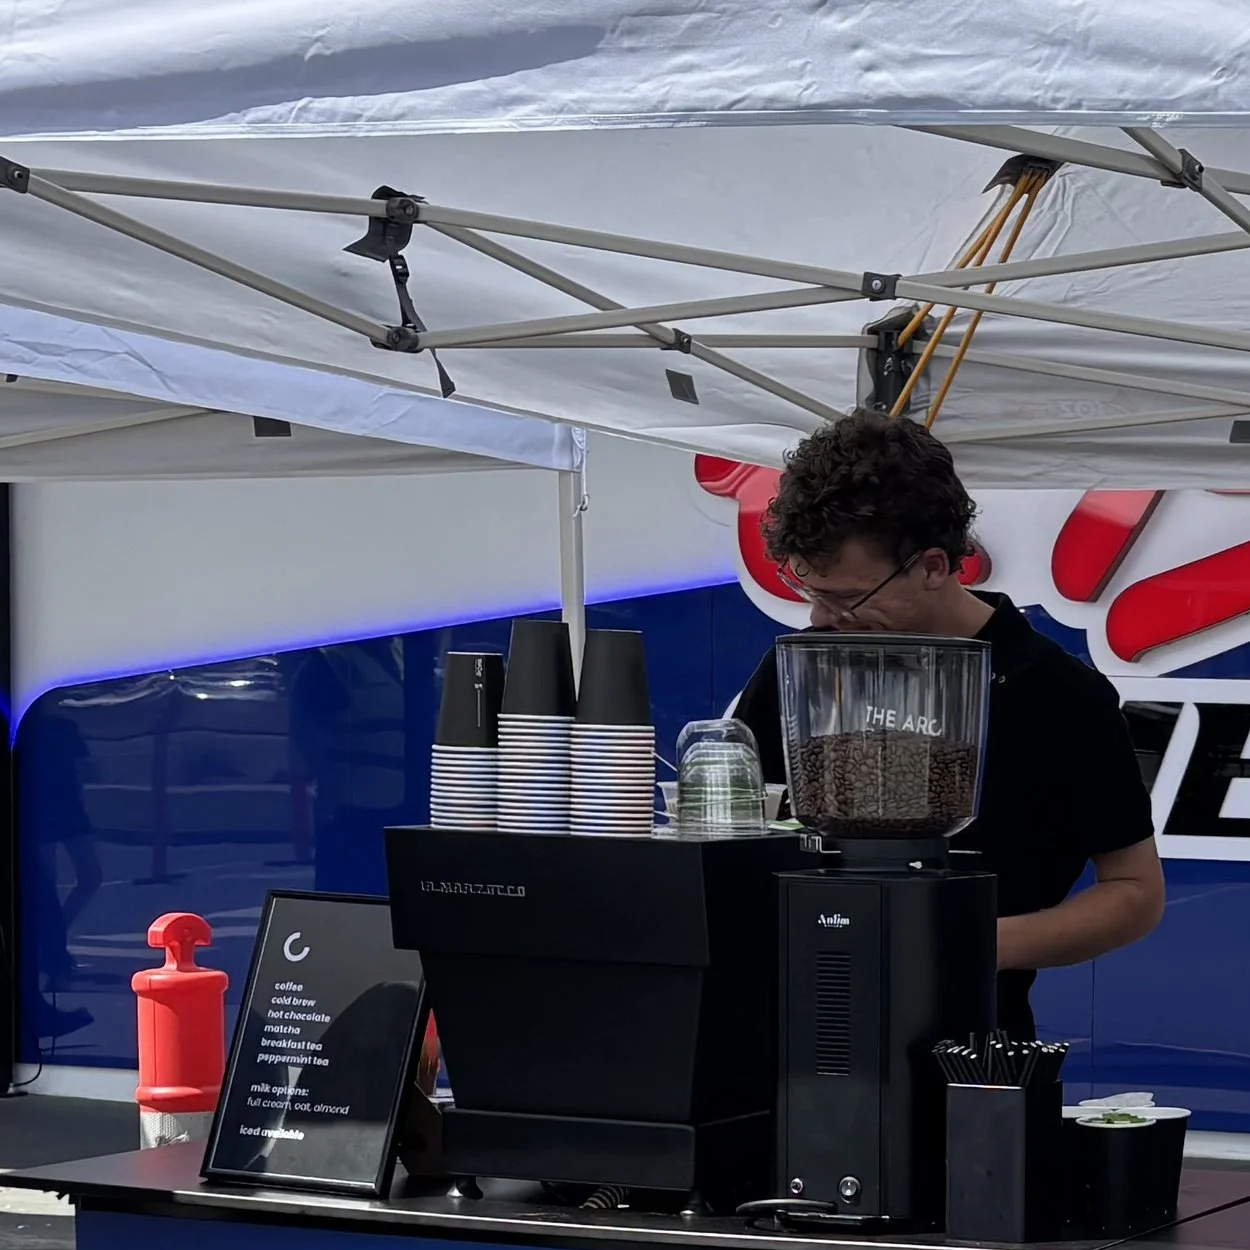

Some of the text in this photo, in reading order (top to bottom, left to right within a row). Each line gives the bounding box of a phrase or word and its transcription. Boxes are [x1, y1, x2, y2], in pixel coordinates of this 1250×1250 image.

[866, 705, 897, 728] THE
[274, 981, 304, 992] coffee
[271, 996, 316, 1007] cold brew
[267, 1009, 331, 1023] hot chocolate
[264, 1023, 301, 1035] matcha
[261, 1037, 323, 1051] breakfast tea
[257, 1052, 330, 1066] peppermint tea
[250, 1083, 270, 1093] milk
[247, 1097, 262, 1107] full
[313, 1103, 350, 1115] almond
